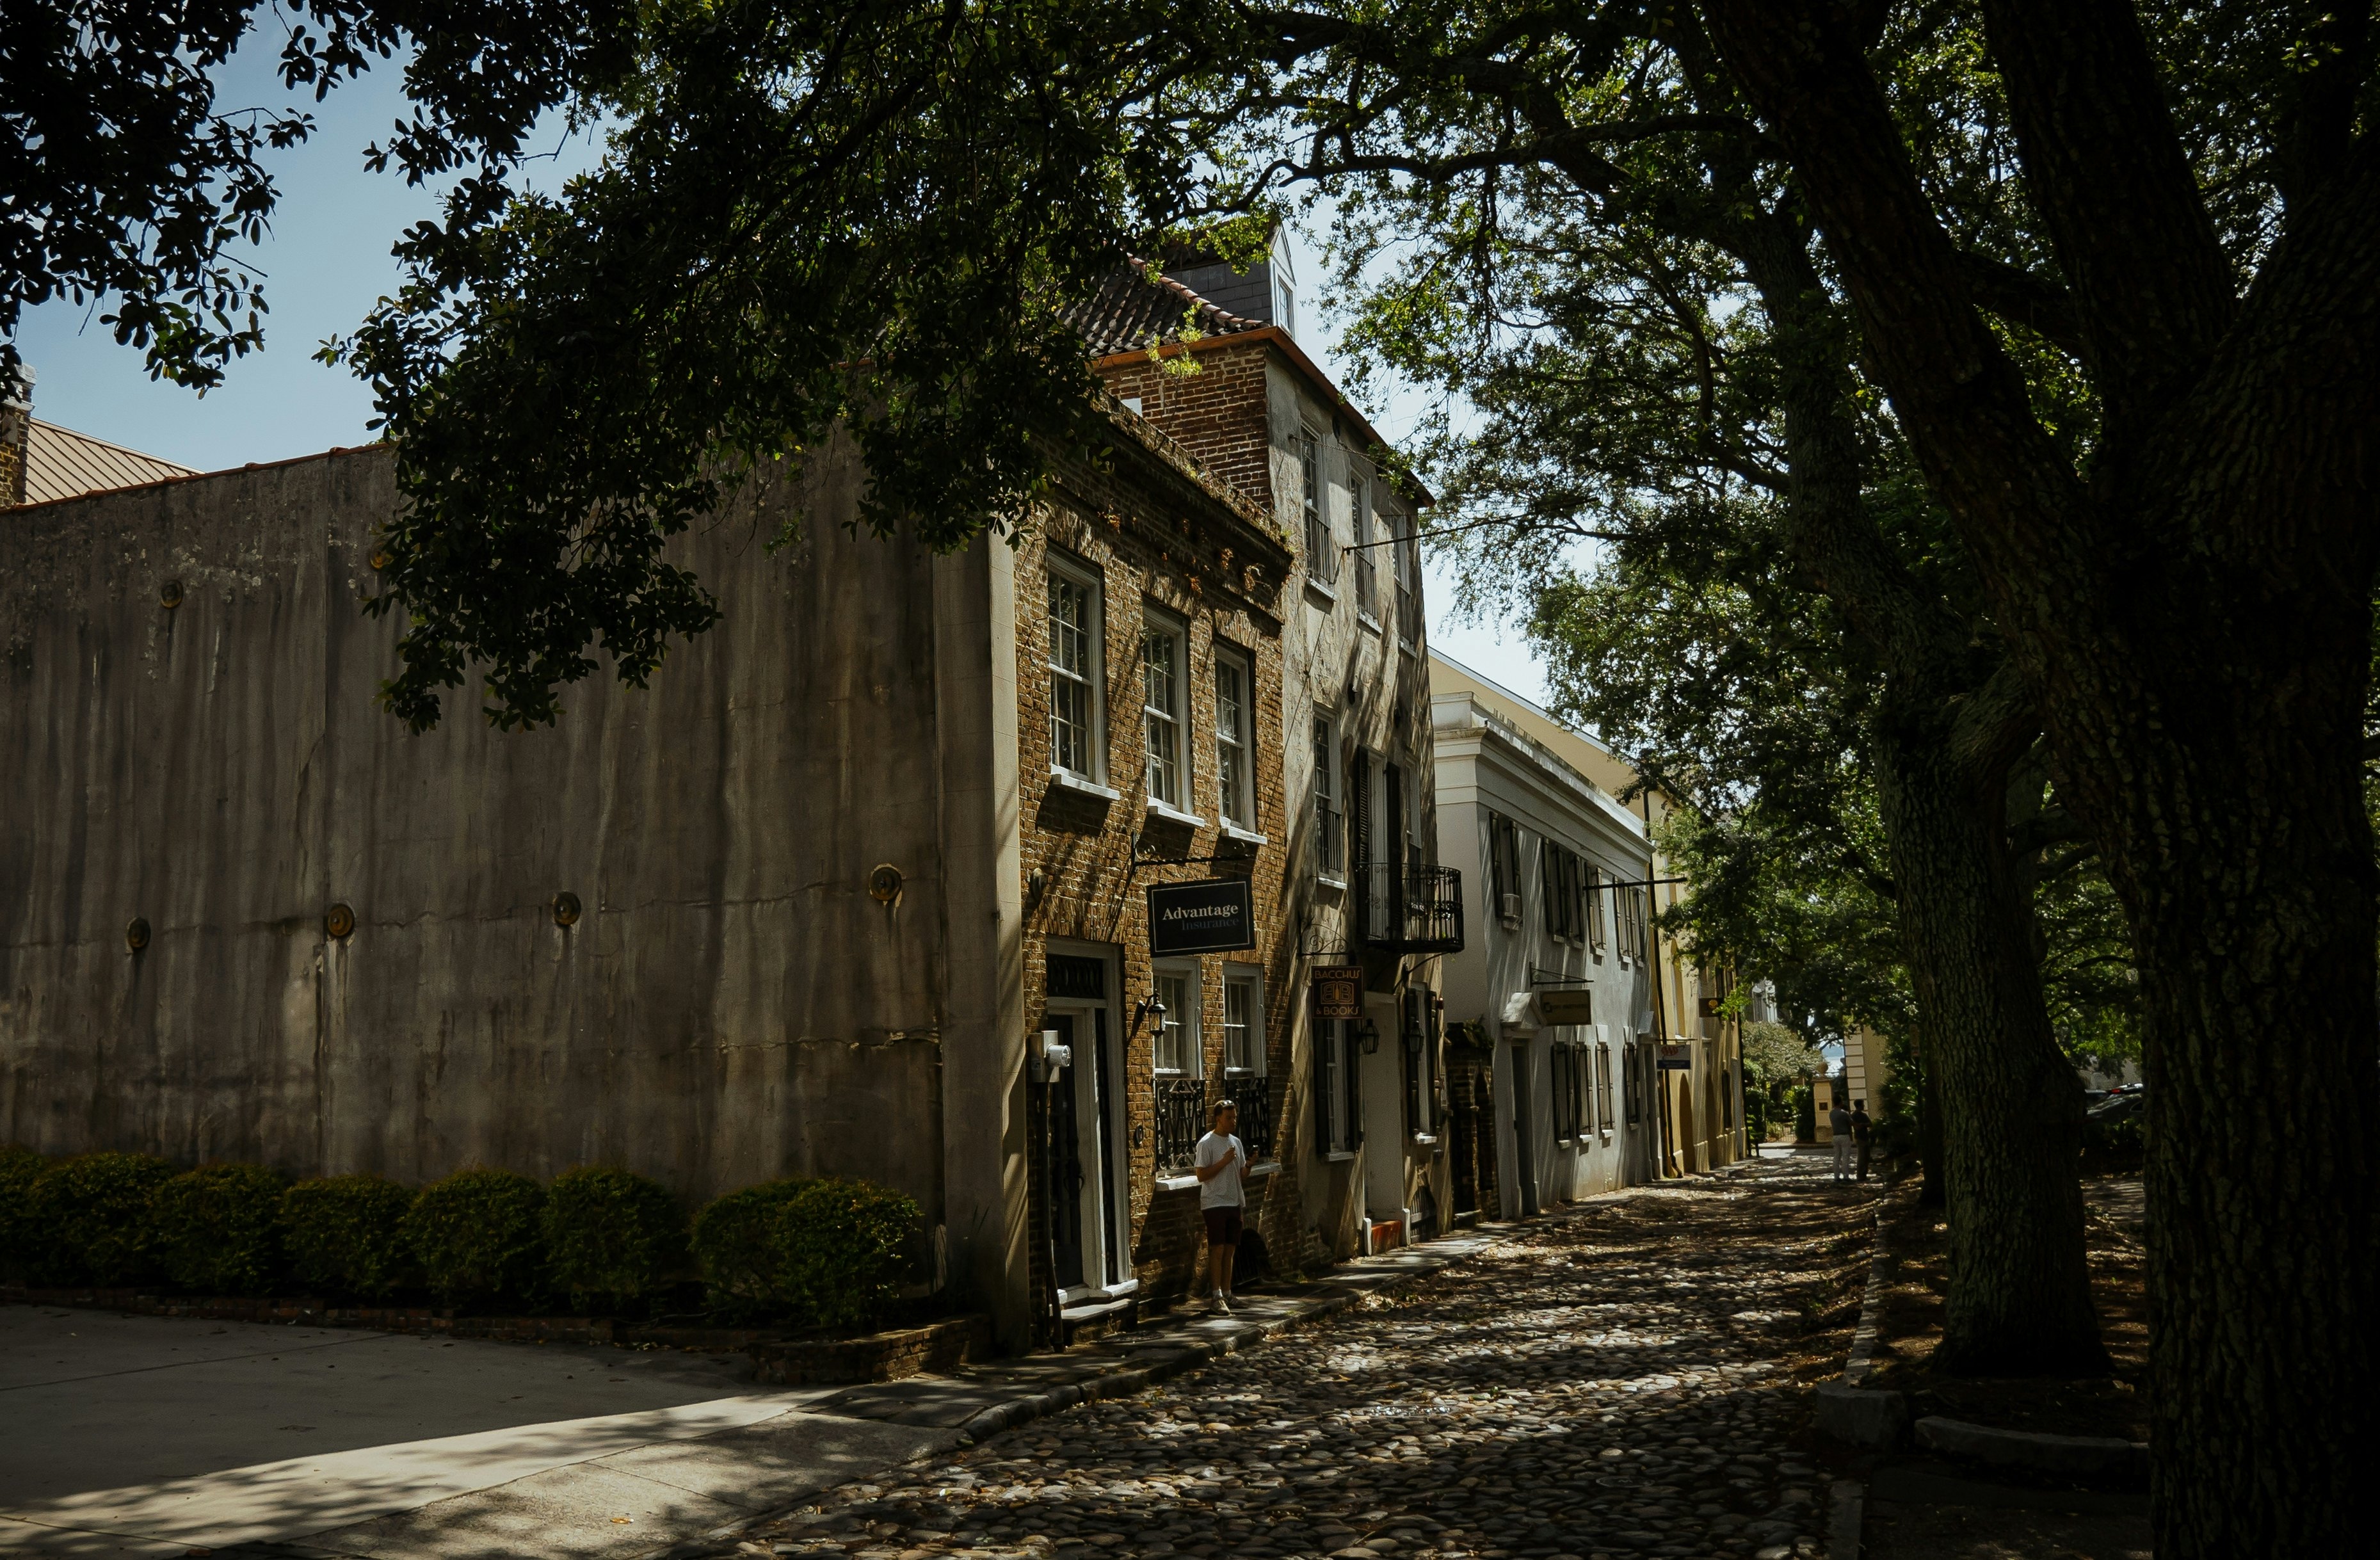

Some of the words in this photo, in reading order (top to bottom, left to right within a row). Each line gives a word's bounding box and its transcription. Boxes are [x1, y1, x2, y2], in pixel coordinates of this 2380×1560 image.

[1162, 905, 1239, 921] Advantage
[1182, 918, 1239, 931] Insurance
[1314, 970, 1360, 979] BACCHUS
[1324, 1006, 1359, 1015] BOOKS
